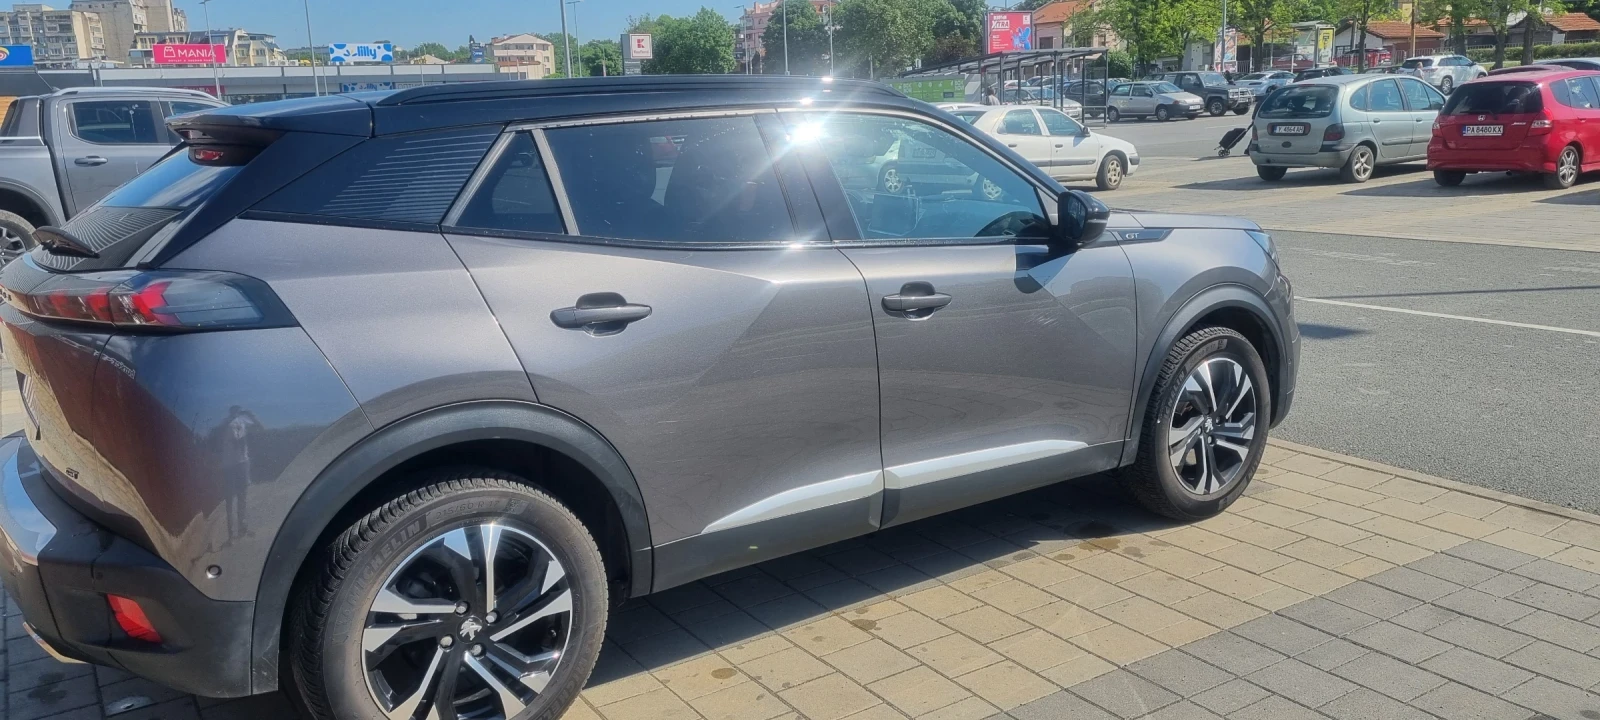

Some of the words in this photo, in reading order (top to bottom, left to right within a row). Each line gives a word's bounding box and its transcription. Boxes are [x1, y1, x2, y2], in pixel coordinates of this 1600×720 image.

[178, 49, 216, 58] MANIA
[357, 46, 377, 59] lilly
[347, 520, 420, 606] MICHELIN
